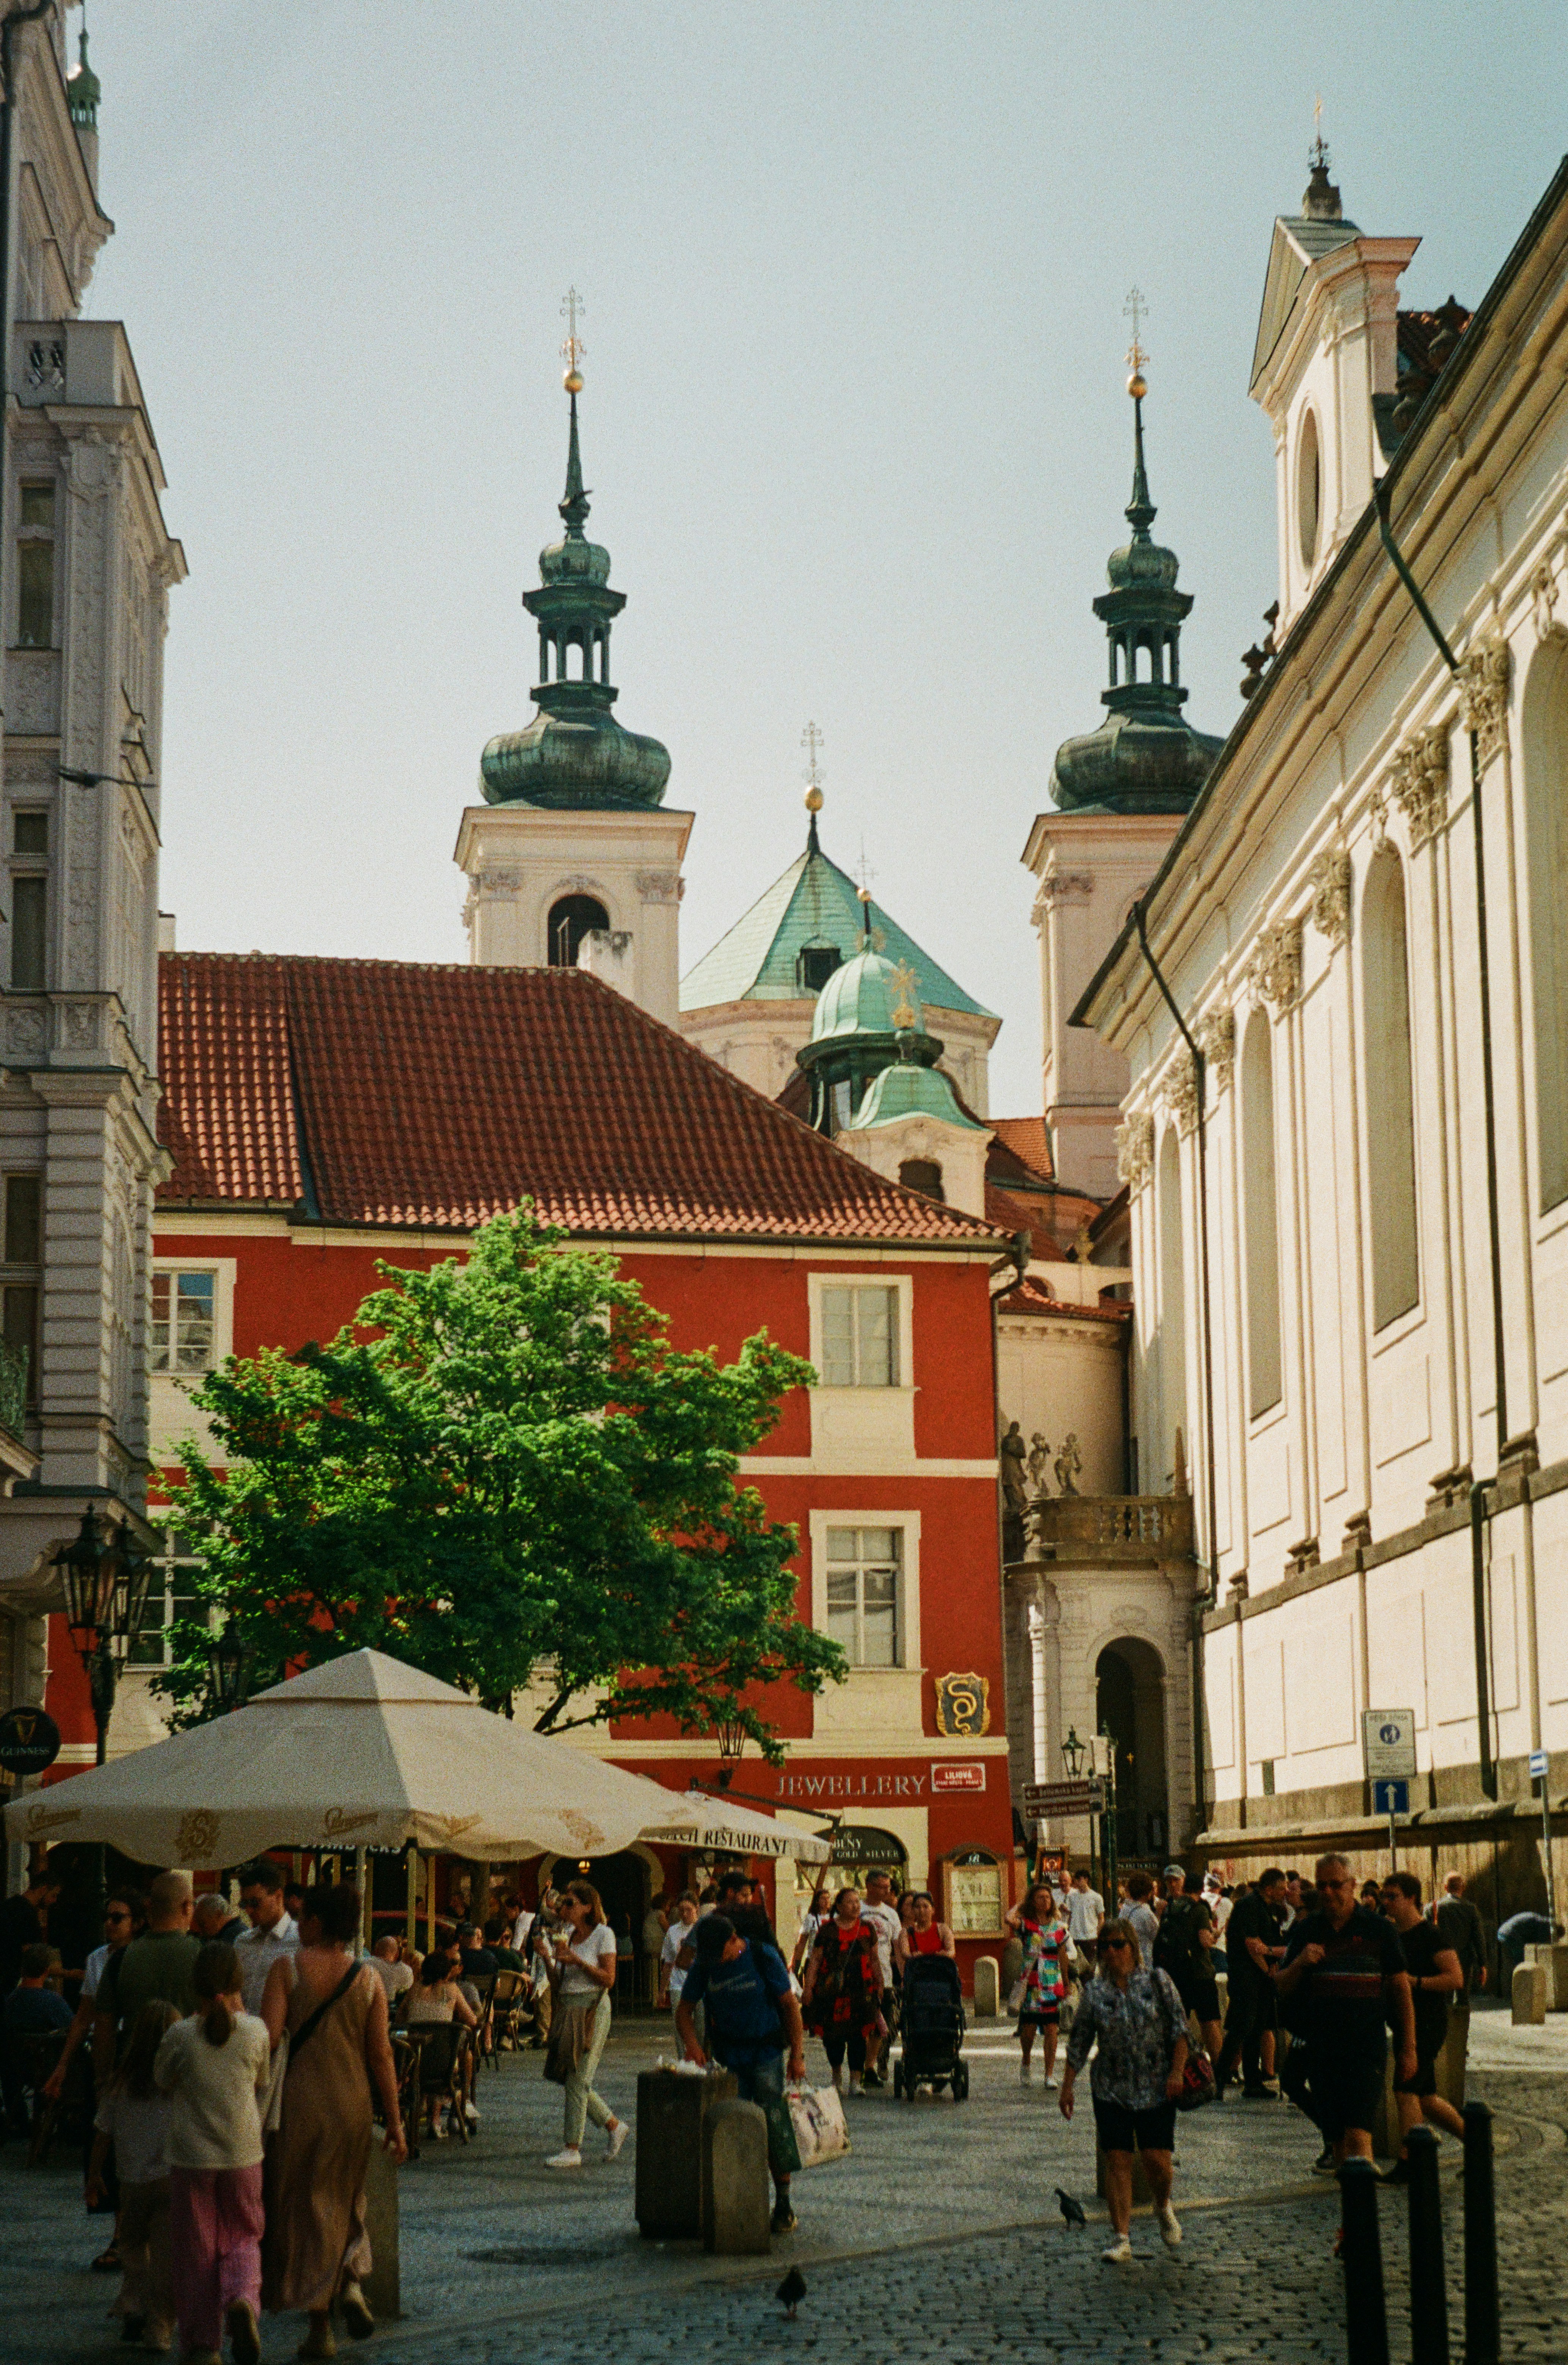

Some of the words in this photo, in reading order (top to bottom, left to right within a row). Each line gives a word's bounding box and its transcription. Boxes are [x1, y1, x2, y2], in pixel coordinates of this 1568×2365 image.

[1, 1746, 50, 1756] GUINNESS
[775, 1775, 926, 1796] JEWELLERY
[704, 1829, 789, 1854] RESTAURANT
[865, 1850, 899, 1858] SILVER
